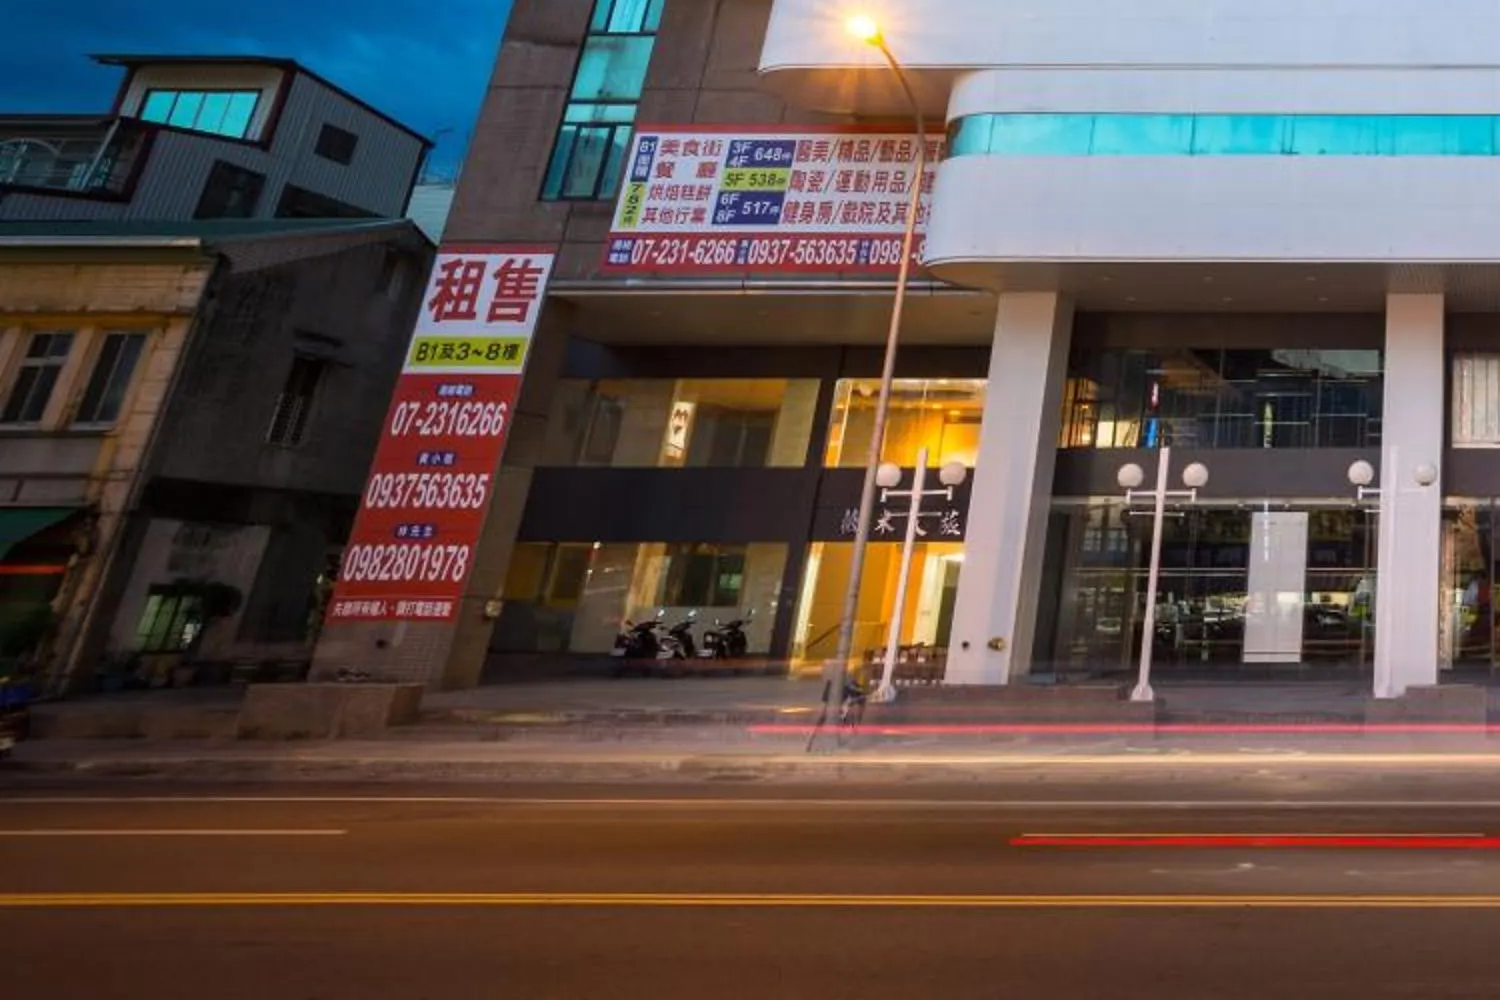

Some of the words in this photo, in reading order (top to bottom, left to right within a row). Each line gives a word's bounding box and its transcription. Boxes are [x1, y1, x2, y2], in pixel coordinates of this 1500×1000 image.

[659, 139, 723, 157] 美食街
[732, 141, 753, 155] 3F
[724, 172, 746, 188] 5F
[720, 193, 741, 206] 6F
[641, 207, 707, 226] 其他行業
[631, 239, 737, 265] 07-231-6266
[747, 239, 858, 265] 0937-563635
[428, 258, 545, 322] 租售
[415, 341, 521, 361] B1及3~8樓
[391, 401, 507, 436] 07-2316266
[365, 472, 489, 508] 0937563635
[343, 543, 469, 582] 0982801978
